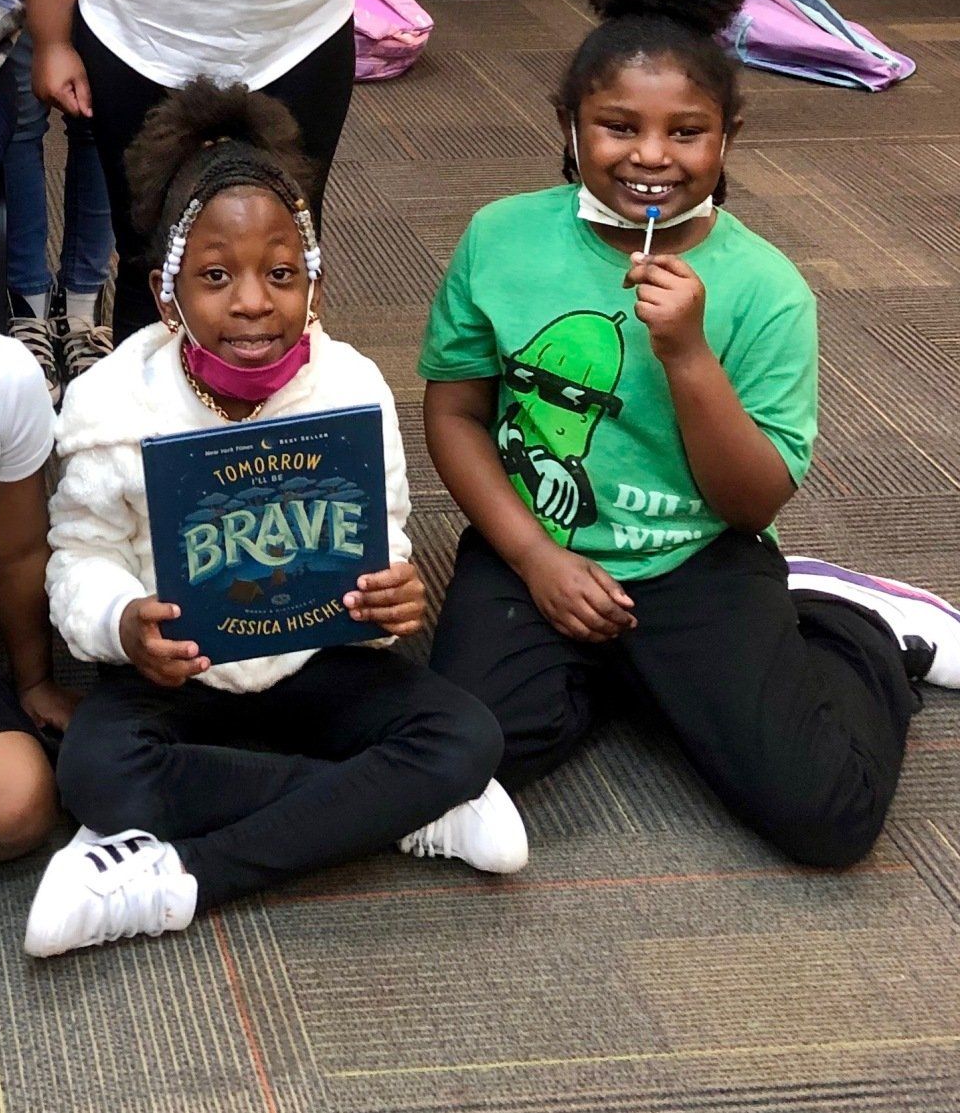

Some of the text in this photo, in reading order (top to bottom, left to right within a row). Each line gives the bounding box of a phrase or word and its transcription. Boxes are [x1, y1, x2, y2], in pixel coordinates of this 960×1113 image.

[212, 452, 322, 486] TOMORROW
[271, 473, 284, 482] BE
[183, 499, 365, 585] BRAVE
[216, 617, 282, 635] JESSICA
[286, 599, 345, 631] HISCHE
